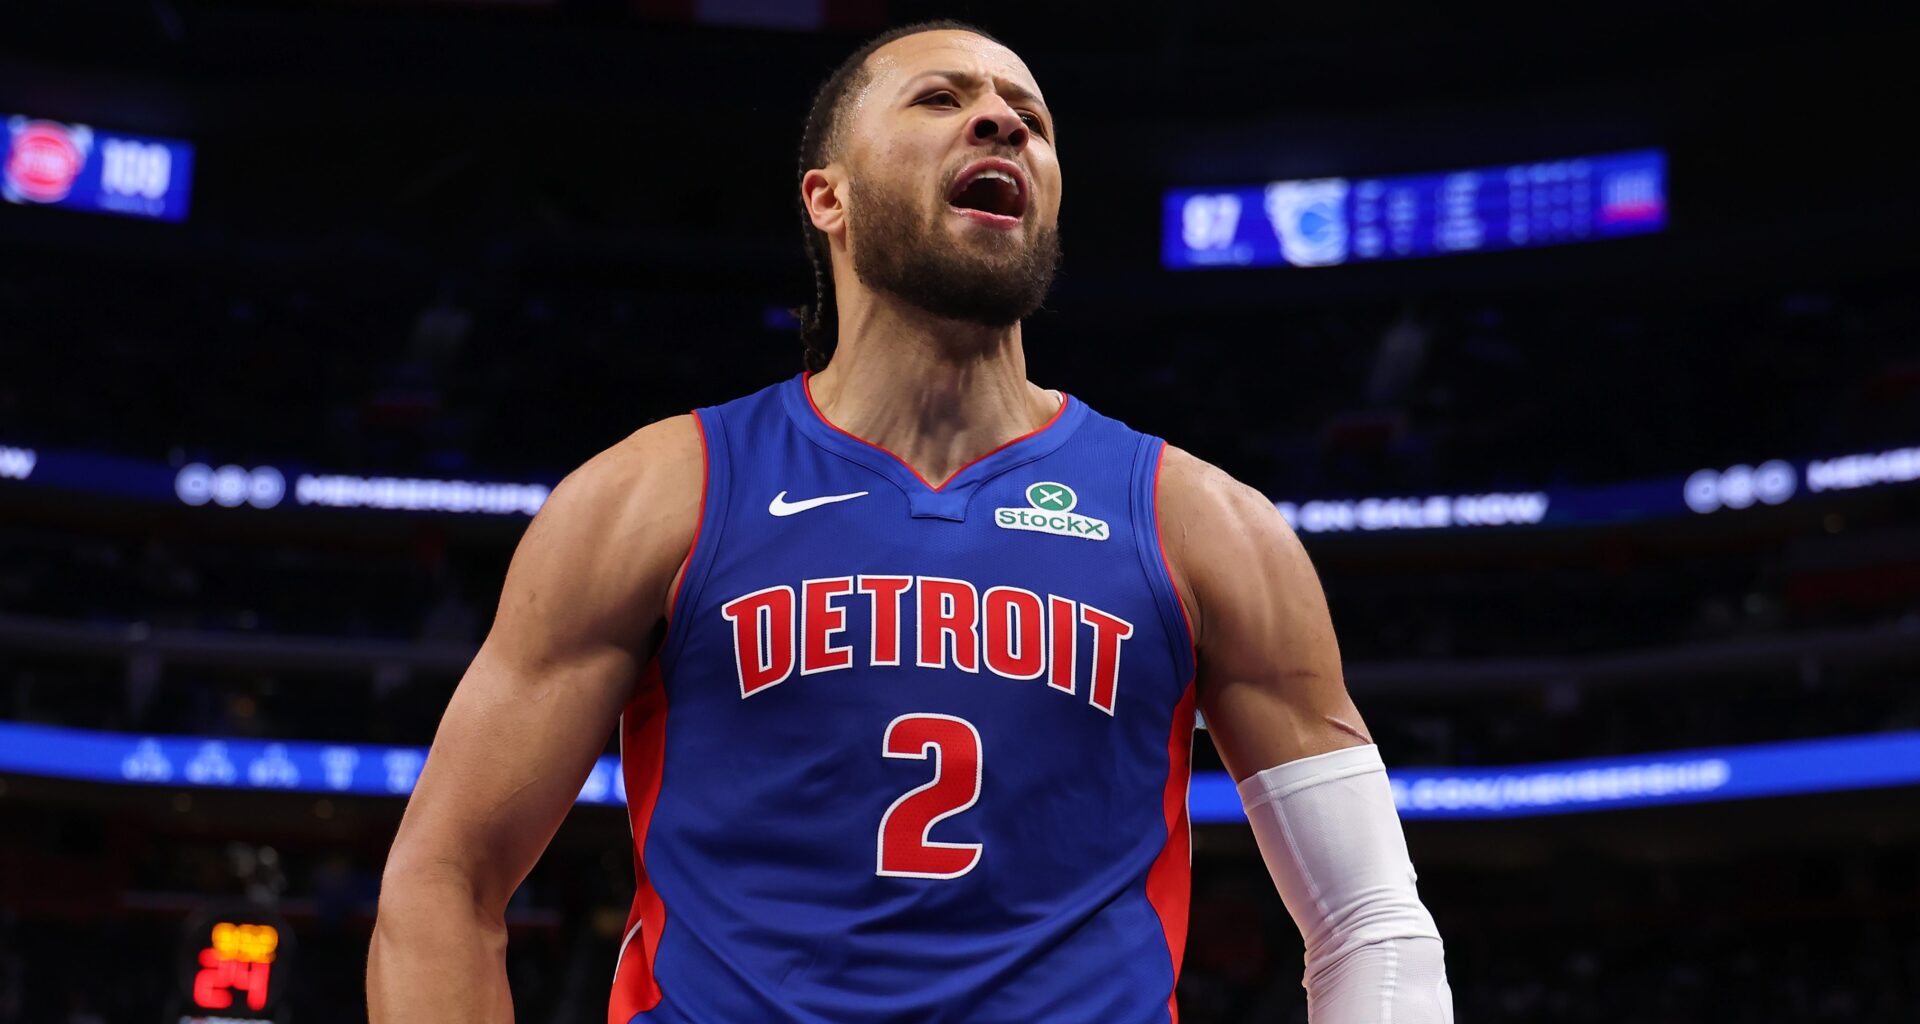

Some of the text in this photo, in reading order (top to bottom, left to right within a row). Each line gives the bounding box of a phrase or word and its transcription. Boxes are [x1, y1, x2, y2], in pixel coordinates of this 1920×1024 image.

[999, 510, 1104, 537] StockX
[1353, 494, 1451, 531] SALE
[1452, 491, 1549, 526] NOW
[721, 574, 1134, 717] DETROIT
[875, 712, 983, 880] 2
[193, 947, 270, 1011] 24
